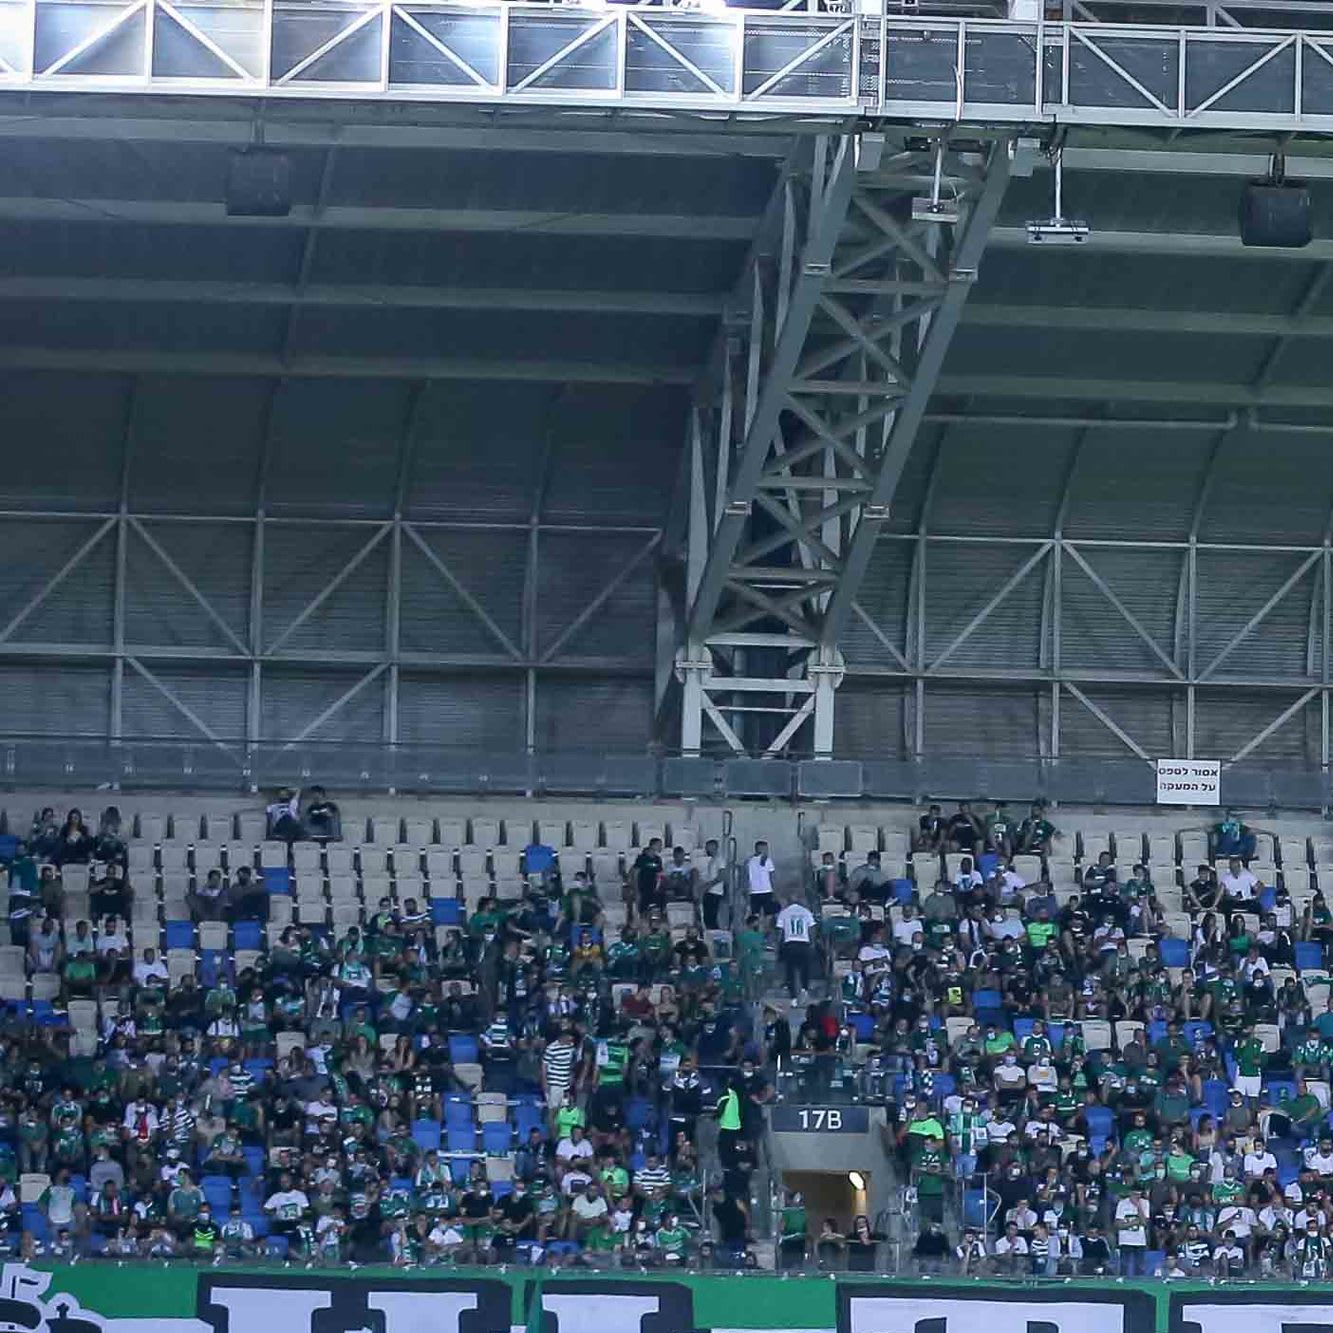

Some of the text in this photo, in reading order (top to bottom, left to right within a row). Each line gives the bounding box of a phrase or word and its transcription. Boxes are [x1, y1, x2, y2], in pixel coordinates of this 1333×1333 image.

[1191, 768, 1218, 777] אסור
[1160, 782, 1216, 792] על המעקה
[798, 1110, 843, 1130] 17B
